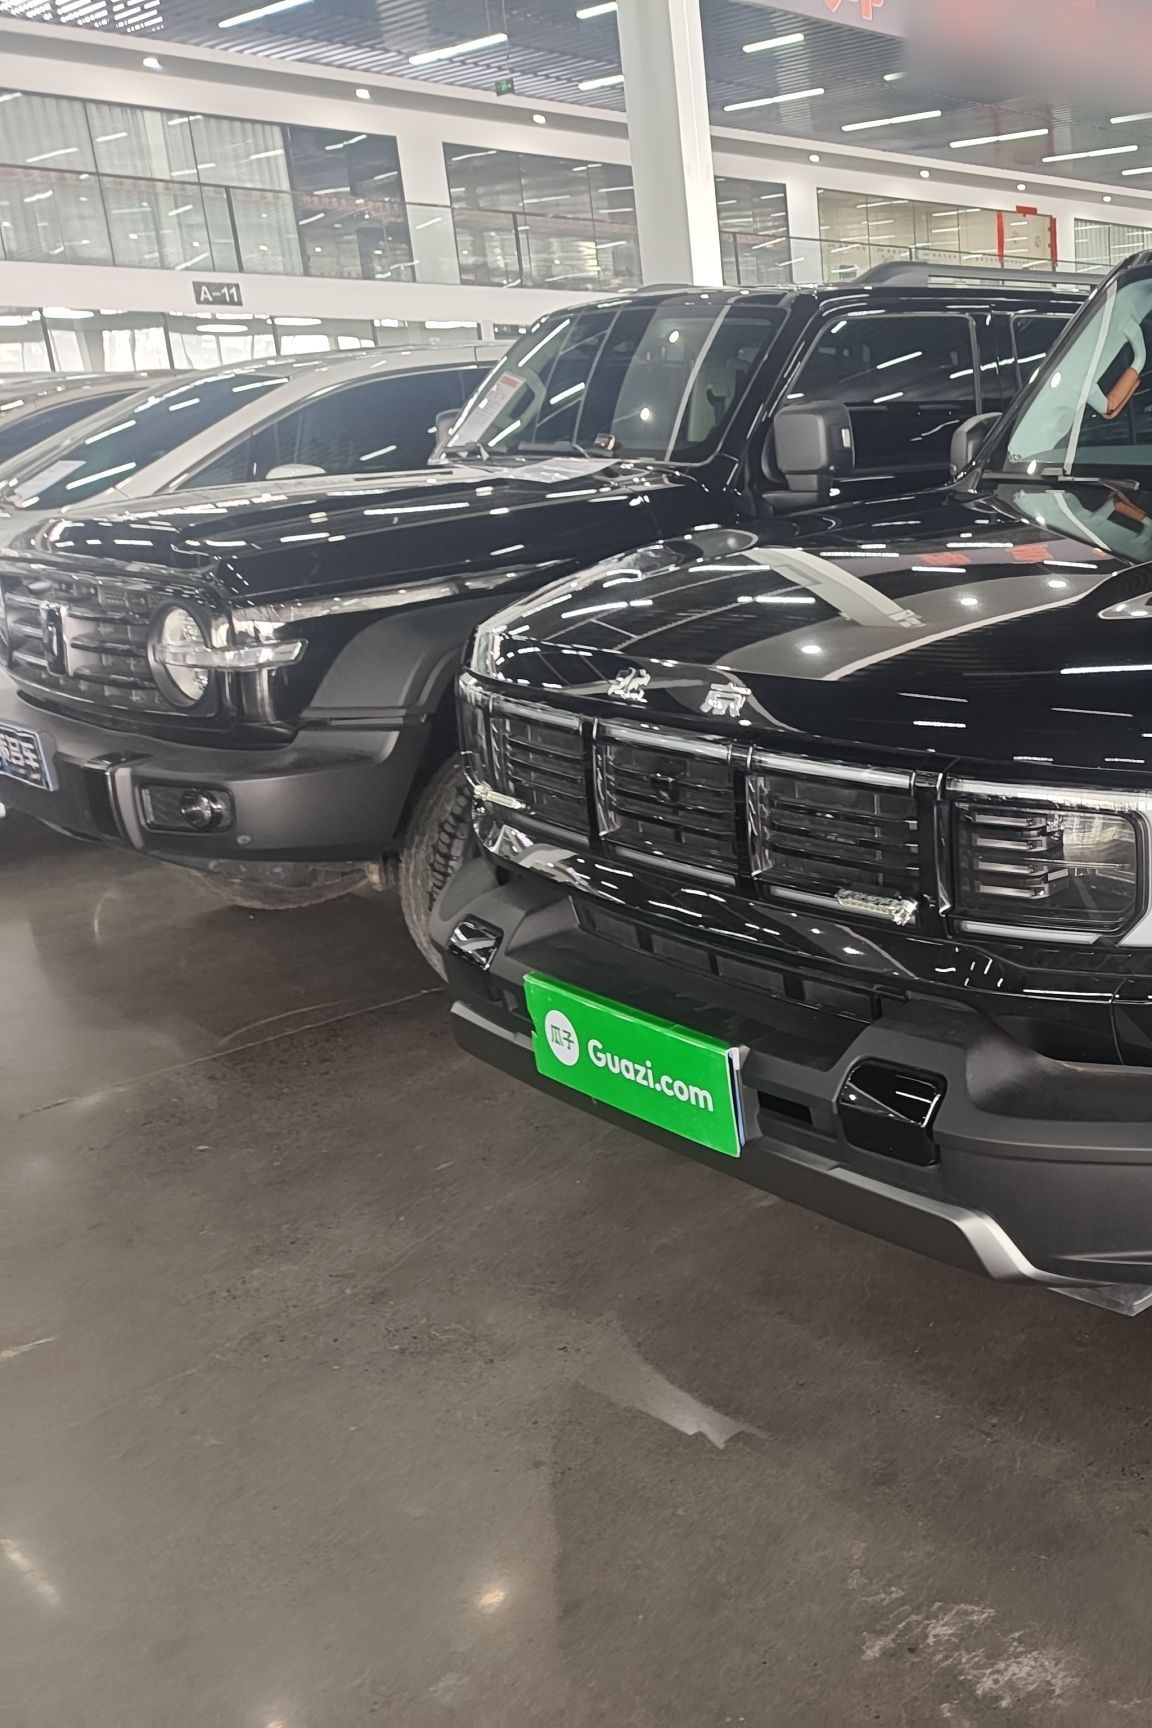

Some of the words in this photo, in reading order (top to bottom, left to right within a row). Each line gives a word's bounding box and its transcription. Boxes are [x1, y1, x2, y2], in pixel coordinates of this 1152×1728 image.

[200, 285, 239, 303] A-11
[549, 1023, 575, 1051] 瓜子
[587, 1039, 714, 1113] Guazi.com
